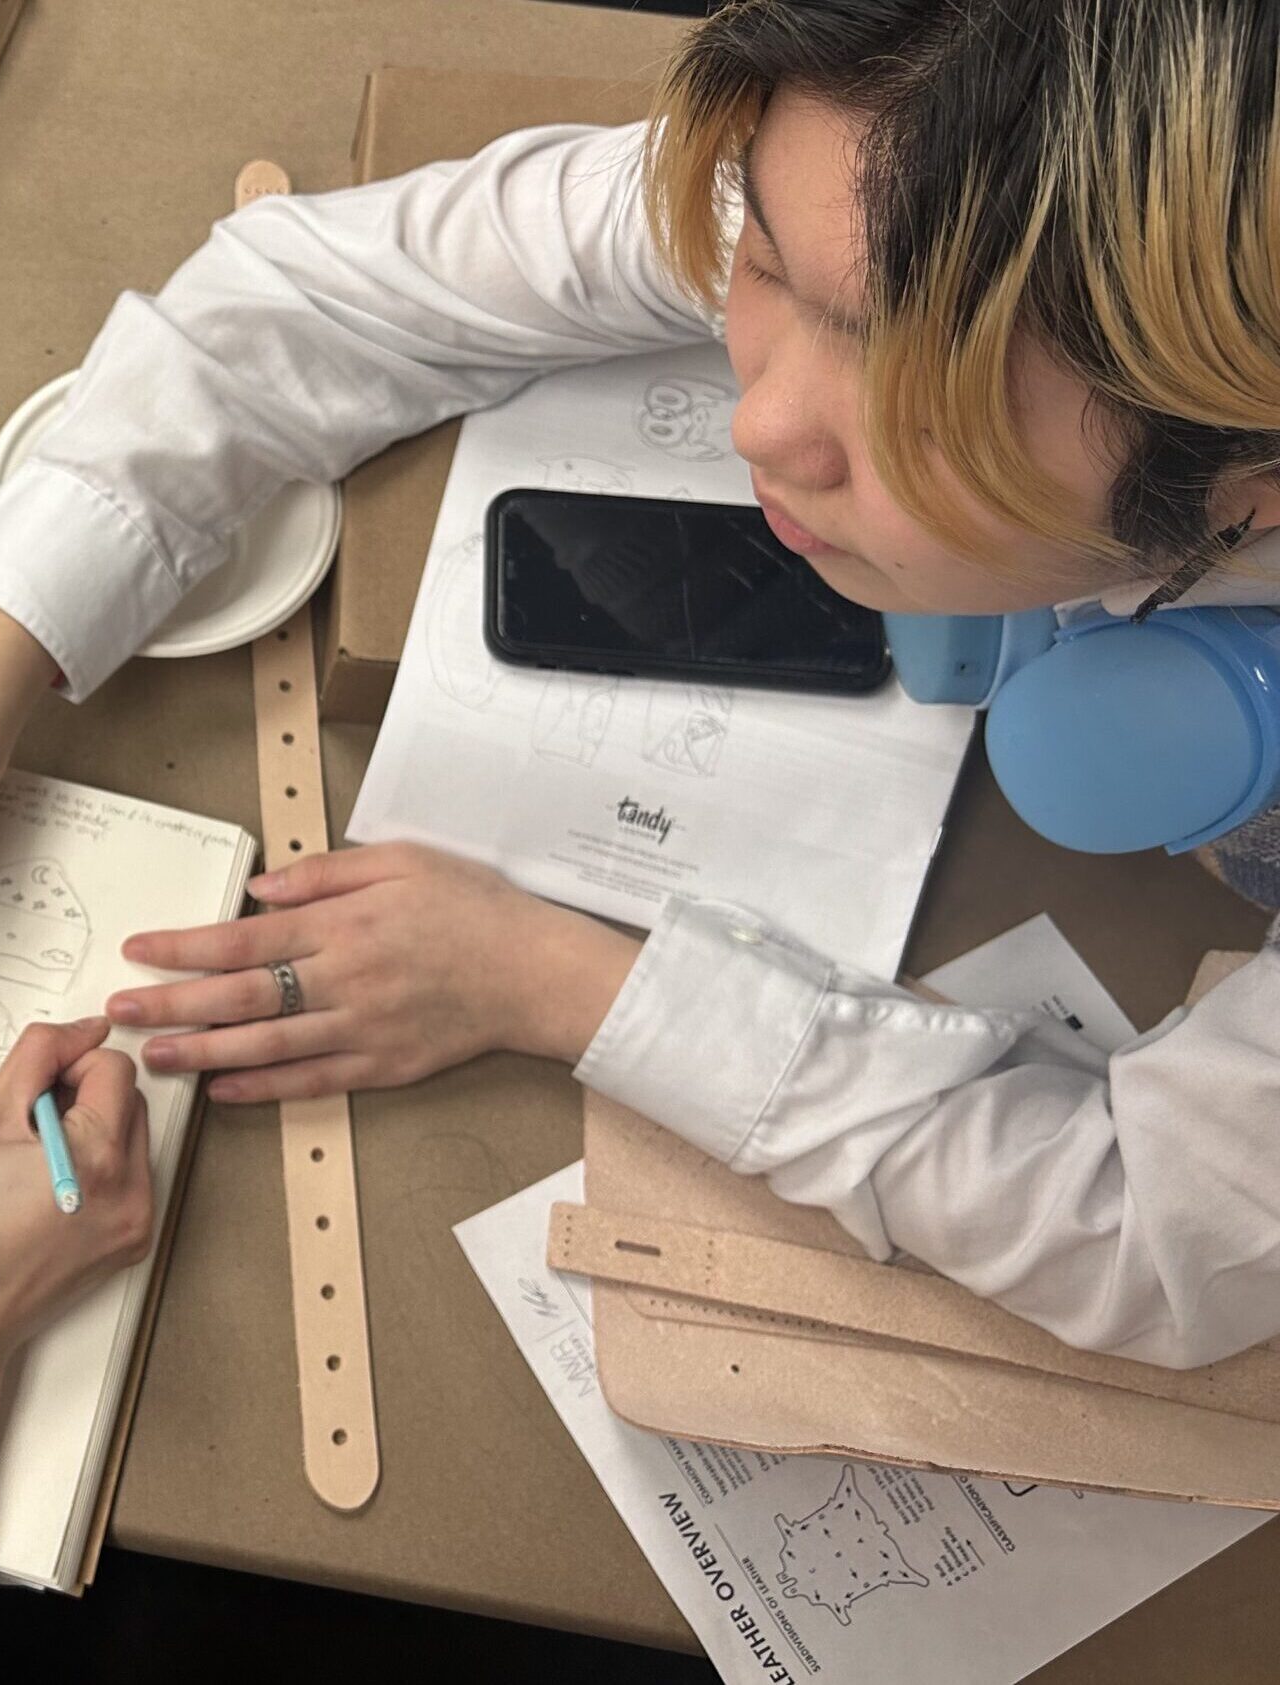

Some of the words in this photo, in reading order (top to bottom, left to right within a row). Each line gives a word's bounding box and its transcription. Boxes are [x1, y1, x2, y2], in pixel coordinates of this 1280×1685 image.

[617, 795, 673, 844] tandy
[658, 1492, 735, 1602] OVERVIEW
[965, 1481, 1016, 1552] CLASSIFICATION
[741, 1556, 770, 1594] LEATHER
[765, 1595, 778, 1609] OF
[729, 1603, 796, 1685] LEATHER
[774, 1609, 822, 1676] SUBDIVISIONS
